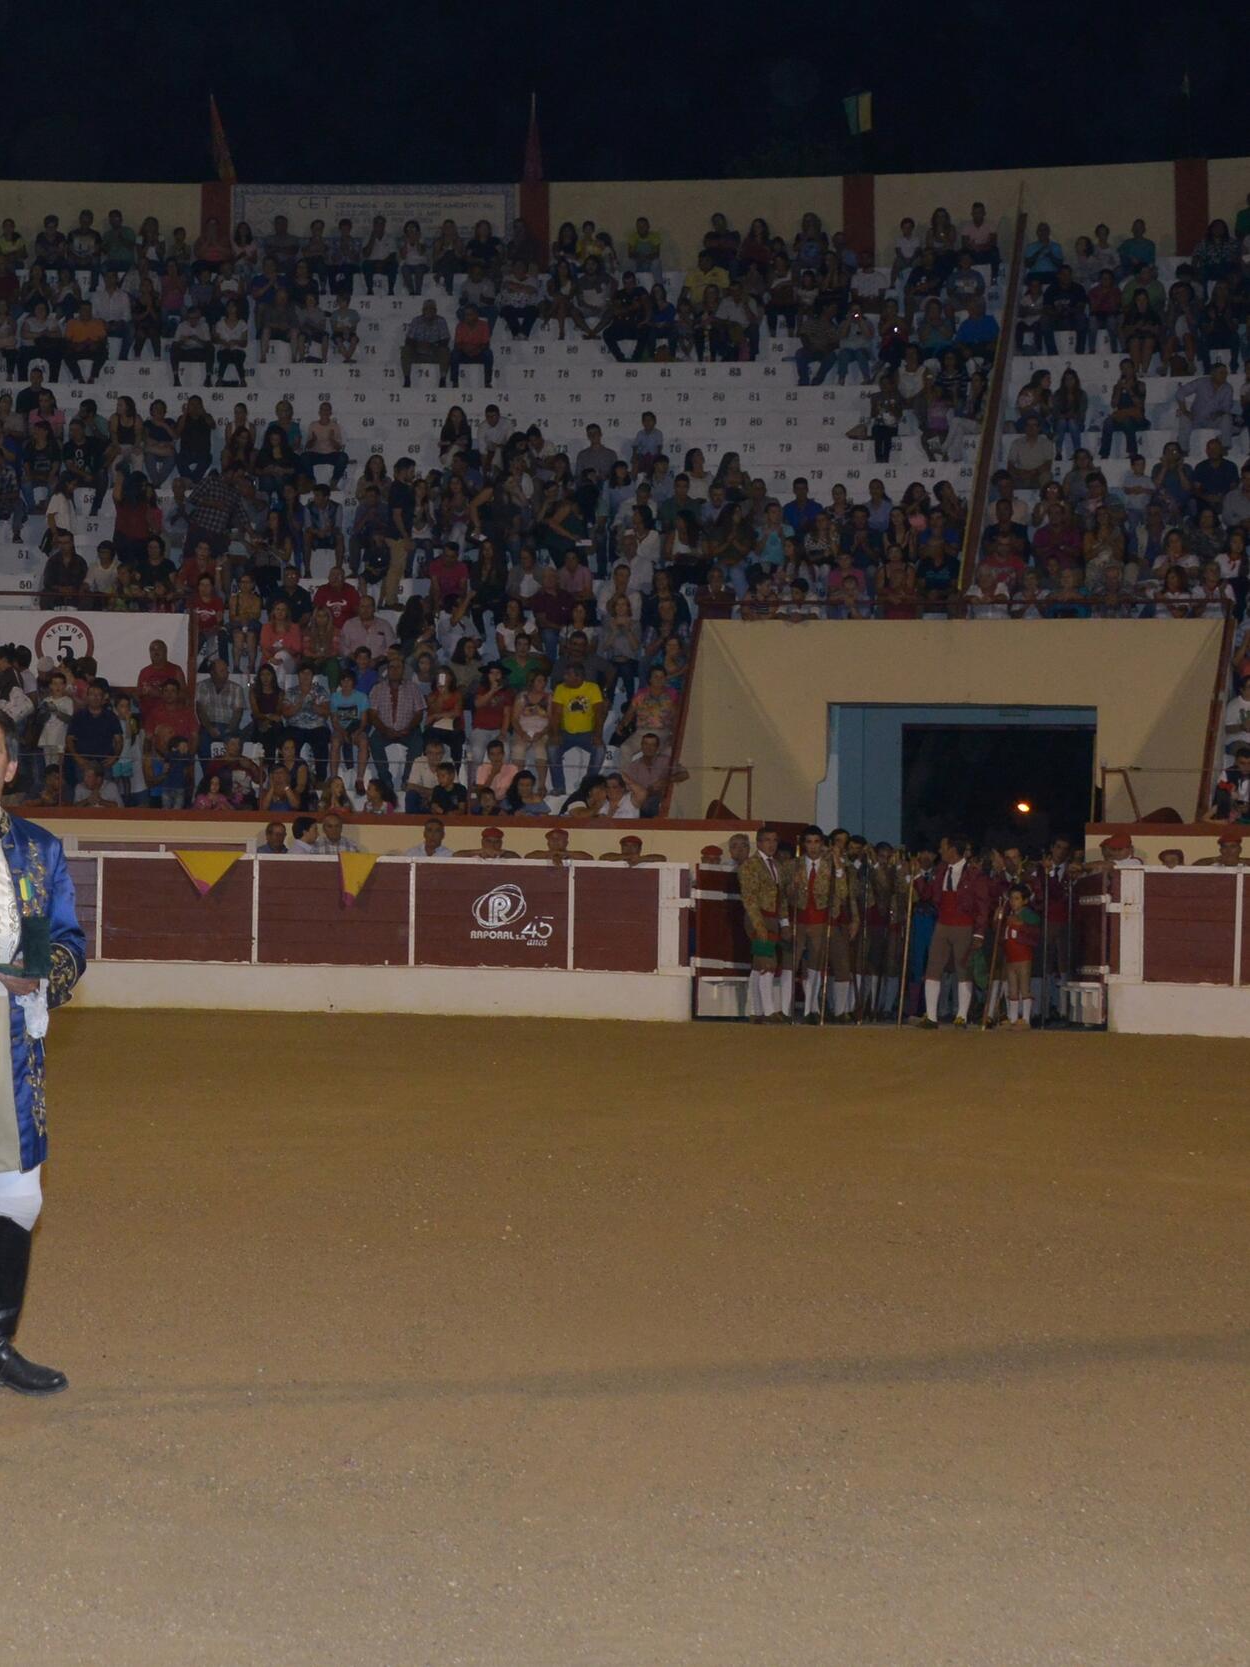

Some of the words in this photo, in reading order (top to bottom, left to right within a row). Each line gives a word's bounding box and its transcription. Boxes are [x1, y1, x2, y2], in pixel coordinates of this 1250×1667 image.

[298, 196, 329, 209] CET
[364, 346, 376, 354] 74
[534, 346, 544, 354] 79
[567, 346, 578, 354] 80
[104, 366, 115, 374] 65
[139, 367, 150, 375] 66
[279, 368, 290, 376] 70
[313, 369, 323, 377] 71
[349, 369, 360, 377] 72
[384, 369, 395, 377] 73
[418, 369, 429, 377] 74
[523, 370, 534, 378] 77
[558, 370, 569, 378] 78
[592, 369, 603, 378] 79
[625, 369, 638, 377] 80
[660, 368, 671, 377] 81
[694, 368, 706, 376] 82
[729, 368, 741, 376] 83
[764, 367, 776, 375] 84
[71, 390, 82, 398] 62
[142, 392, 154, 400] 64
[212, 392, 223, 401] 66
[247, 393, 258, 401] 67
[283, 393, 294, 402] 68
[319, 393, 330, 402] 69
[354, 394, 365, 402] 70
[390, 394, 400, 402] 71
[425, 394, 437, 402] 72
[462, 394, 473, 402] 73
[498, 393, 509, 402] 74
[534, 394, 546, 402] 75
[569, 394, 581, 402] 76
[605, 394, 615, 402] 77
[641, 393, 652, 402] 78
[677, 393, 689, 401] 79
[713, 392, 725, 401] 80
[749, 392, 759, 401] 81
[786, 392, 797, 400] 82
[823, 392, 835, 400] 83
[362, 418, 374, 427] 69
[398, 418, 409, 427] 70
[572, 419, 584, 427] 75
[608, 417, 619, 426] 76
[679, 418, 691, 426] 78
[715, 418, 726, 426] 79
[750, 417, 762, 426] 80
[786, 418, 797, 426] 81
[823, 417, 835, 425] 82
[371, 445, 383, 453] 68
[408, 445, 420, 453] 69
[670, 444, 681, 453] 76
[707, 444, 718, 452] 77
[743, 444, 755, 452] 78
[780, 444, 791, 452] 79
[817, 443, 829, 452] 80
[852, 443, 864, 452] 81
[774, 471, 786, 479] 78
[811, 470, 822, 479] 79
[847, 470, 860, 479] 80
[885, 470, 896, 478] 81
[922, 469, 934, 478] 82
[960, 468, 973, 477] 83
[87, 523, 98, 532] 57
[18, 550, 30, 559] 51
[20, 581, 32, 589] 50
[46, 625, 84, 640] SECTOR
[57, 636, 74, 662] 5
[521, 922, 553, 938] 45
[470, 930, 514, 940] RAPORAL
